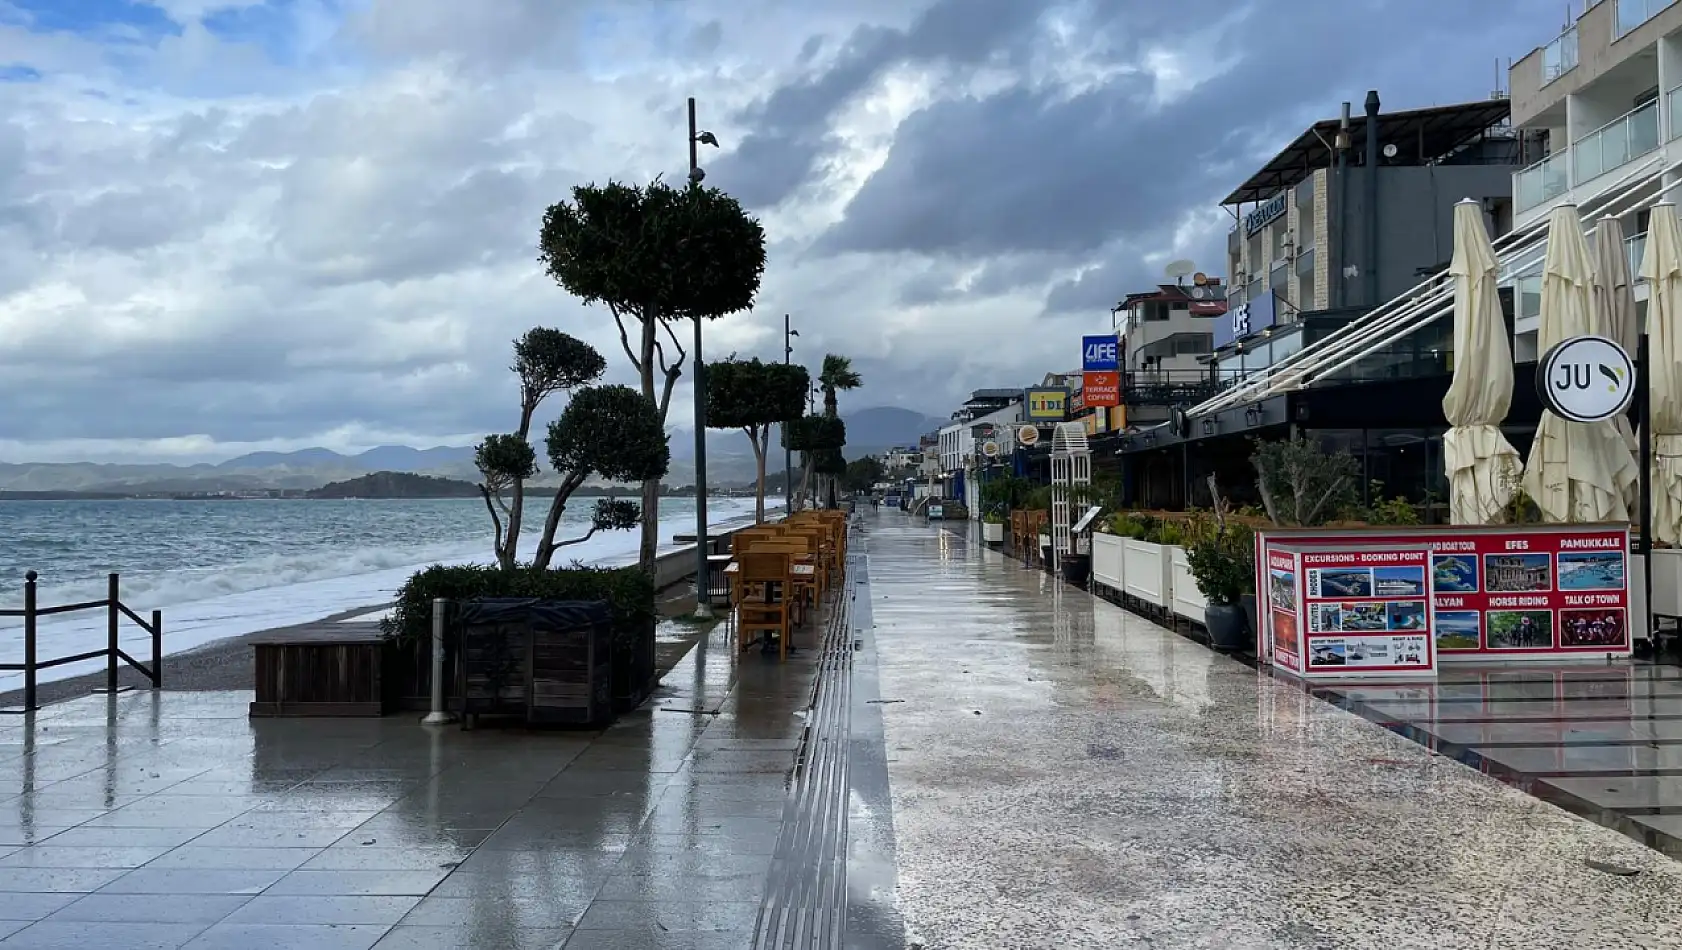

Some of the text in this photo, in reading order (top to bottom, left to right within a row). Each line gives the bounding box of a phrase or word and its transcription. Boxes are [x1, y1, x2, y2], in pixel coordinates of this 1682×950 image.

[1086, 343, 1116, 359] LIFE
[1556, 364, 1590, 389] JU
[1442, 541, 1458, 550] BOAT
[1459, 541, 1476, 550] TOUR
[1505, 540, 1529, 549] EFES
[1560, 538, 1620, 548] PAMUKKALE
[1304, 554, 1355, 563] EXCURSIONS
[1361, 553, 1398, 561] BOOKING
[1400, 552, 1424, 560] POINT
[1434, 597, 1463, 606] ALYAN
[1489, 596, 1549, 606] HORSE RIDING
[1564, 594, 1620, 605] TALK OF TOWN
